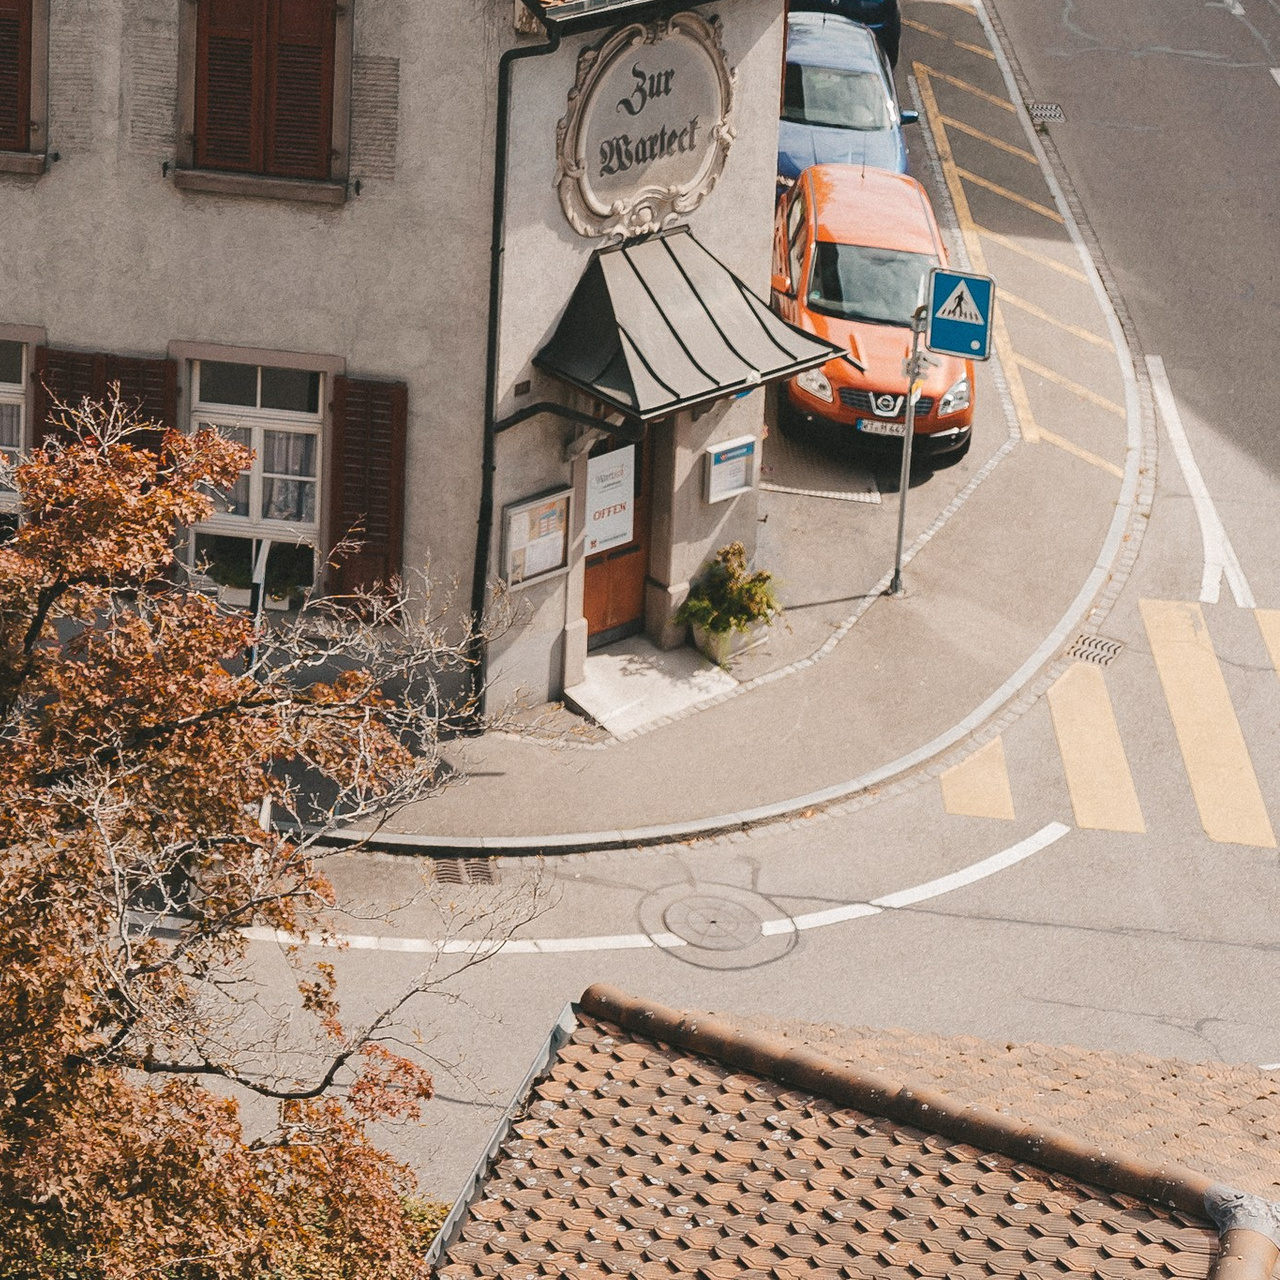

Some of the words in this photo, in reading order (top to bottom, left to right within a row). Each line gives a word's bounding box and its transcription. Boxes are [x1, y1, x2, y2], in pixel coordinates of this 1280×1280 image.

[616, 61, 675, 116] Zur
[599, 114, 702, 178] Warteck
[593, 501, 627, 521] OFFEN
